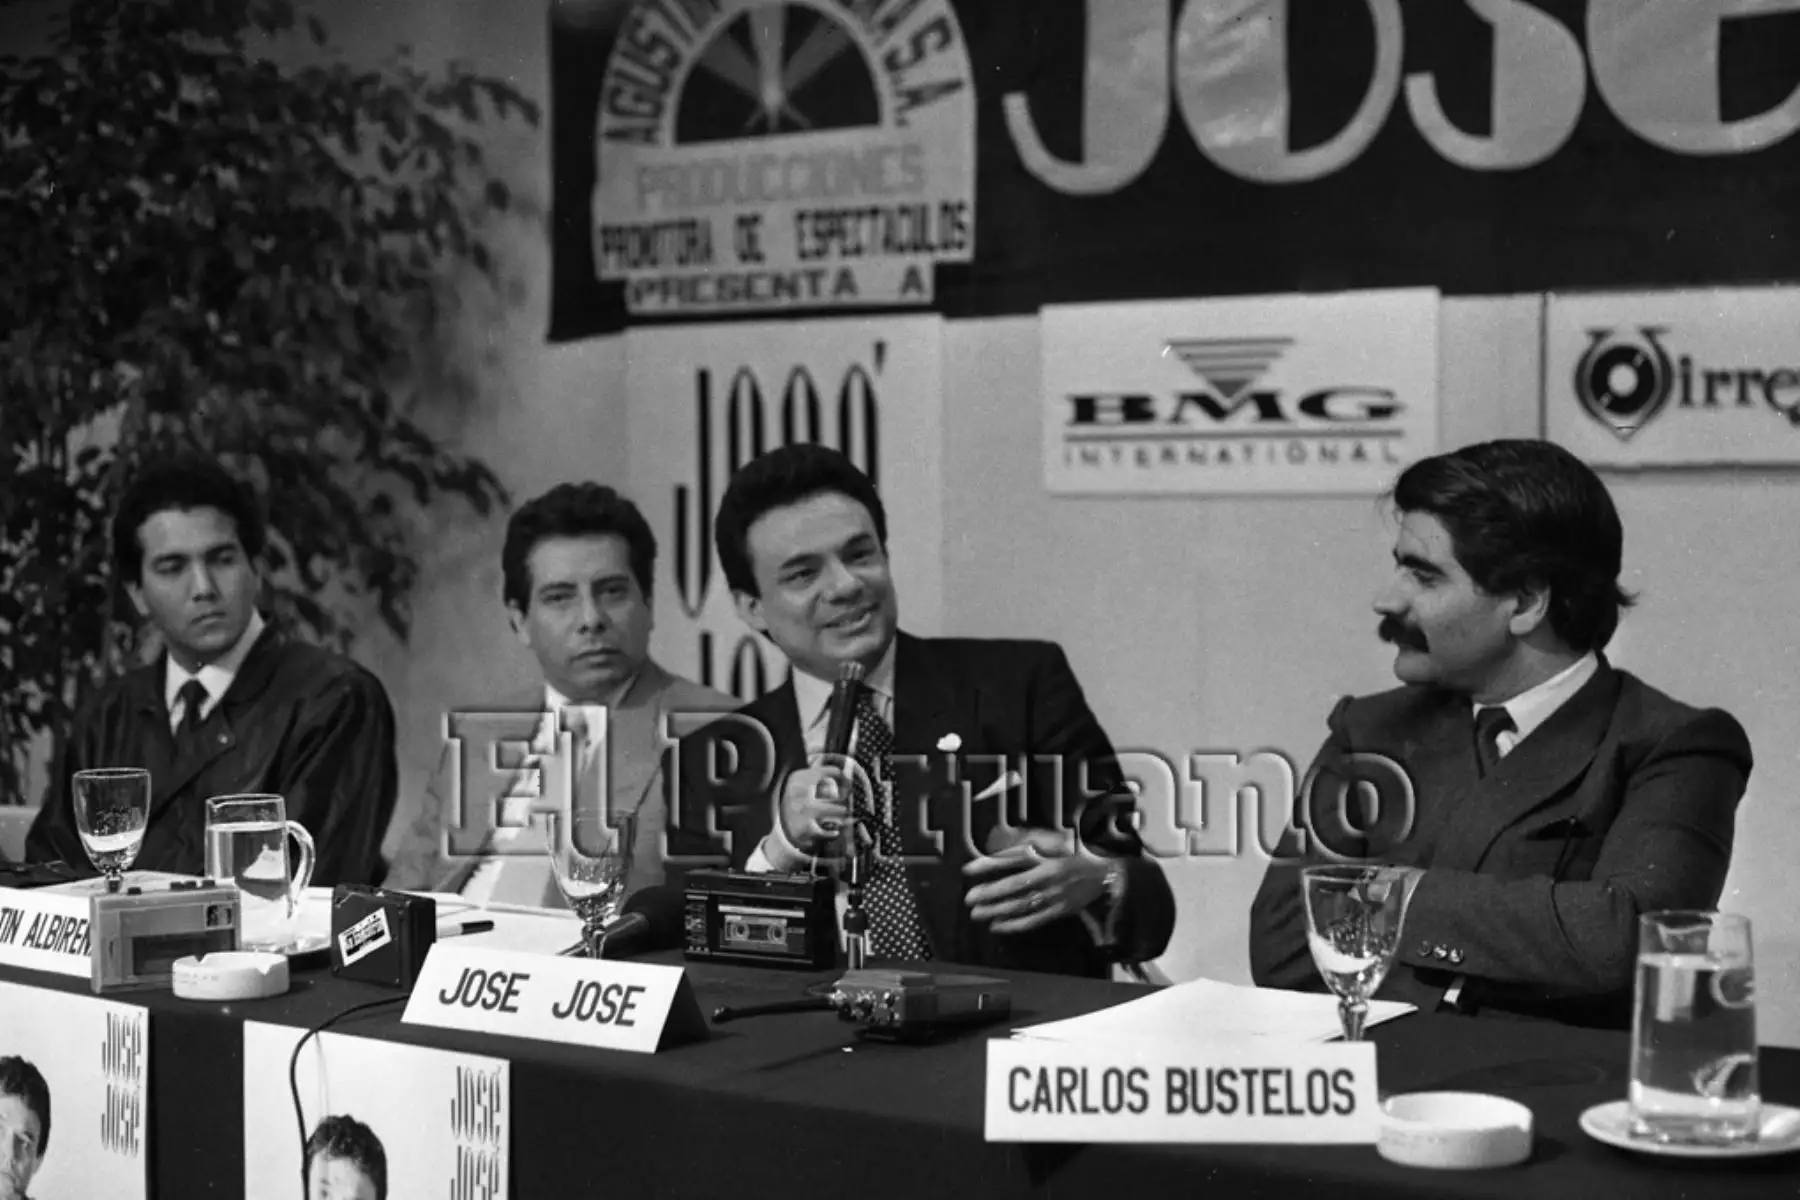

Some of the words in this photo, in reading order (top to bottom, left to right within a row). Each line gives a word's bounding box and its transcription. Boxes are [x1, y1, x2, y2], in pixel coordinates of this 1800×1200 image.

[637, 144, 926, 211] PRODUCCIONES
[736, 212, 766, 262] DE
[796, 201, 970, 260] ESPECTACULOS
[632, 267, 858, 305] PRESENTA
[901, 264, 926, 295] A
[1066, 385, 1406, 427] BMG
[1575, 325, 1800, 441] Virre
[1064, 438, 1402, 468] INTERNATIONAL
[438, 967, 531, 1014] JOSE
[551, 979, 647, 1027] JOSE
[1007, 1065, 1151, 1115] CARLOS
[1164, 1066, 1357, 1117] BUSTELOS
